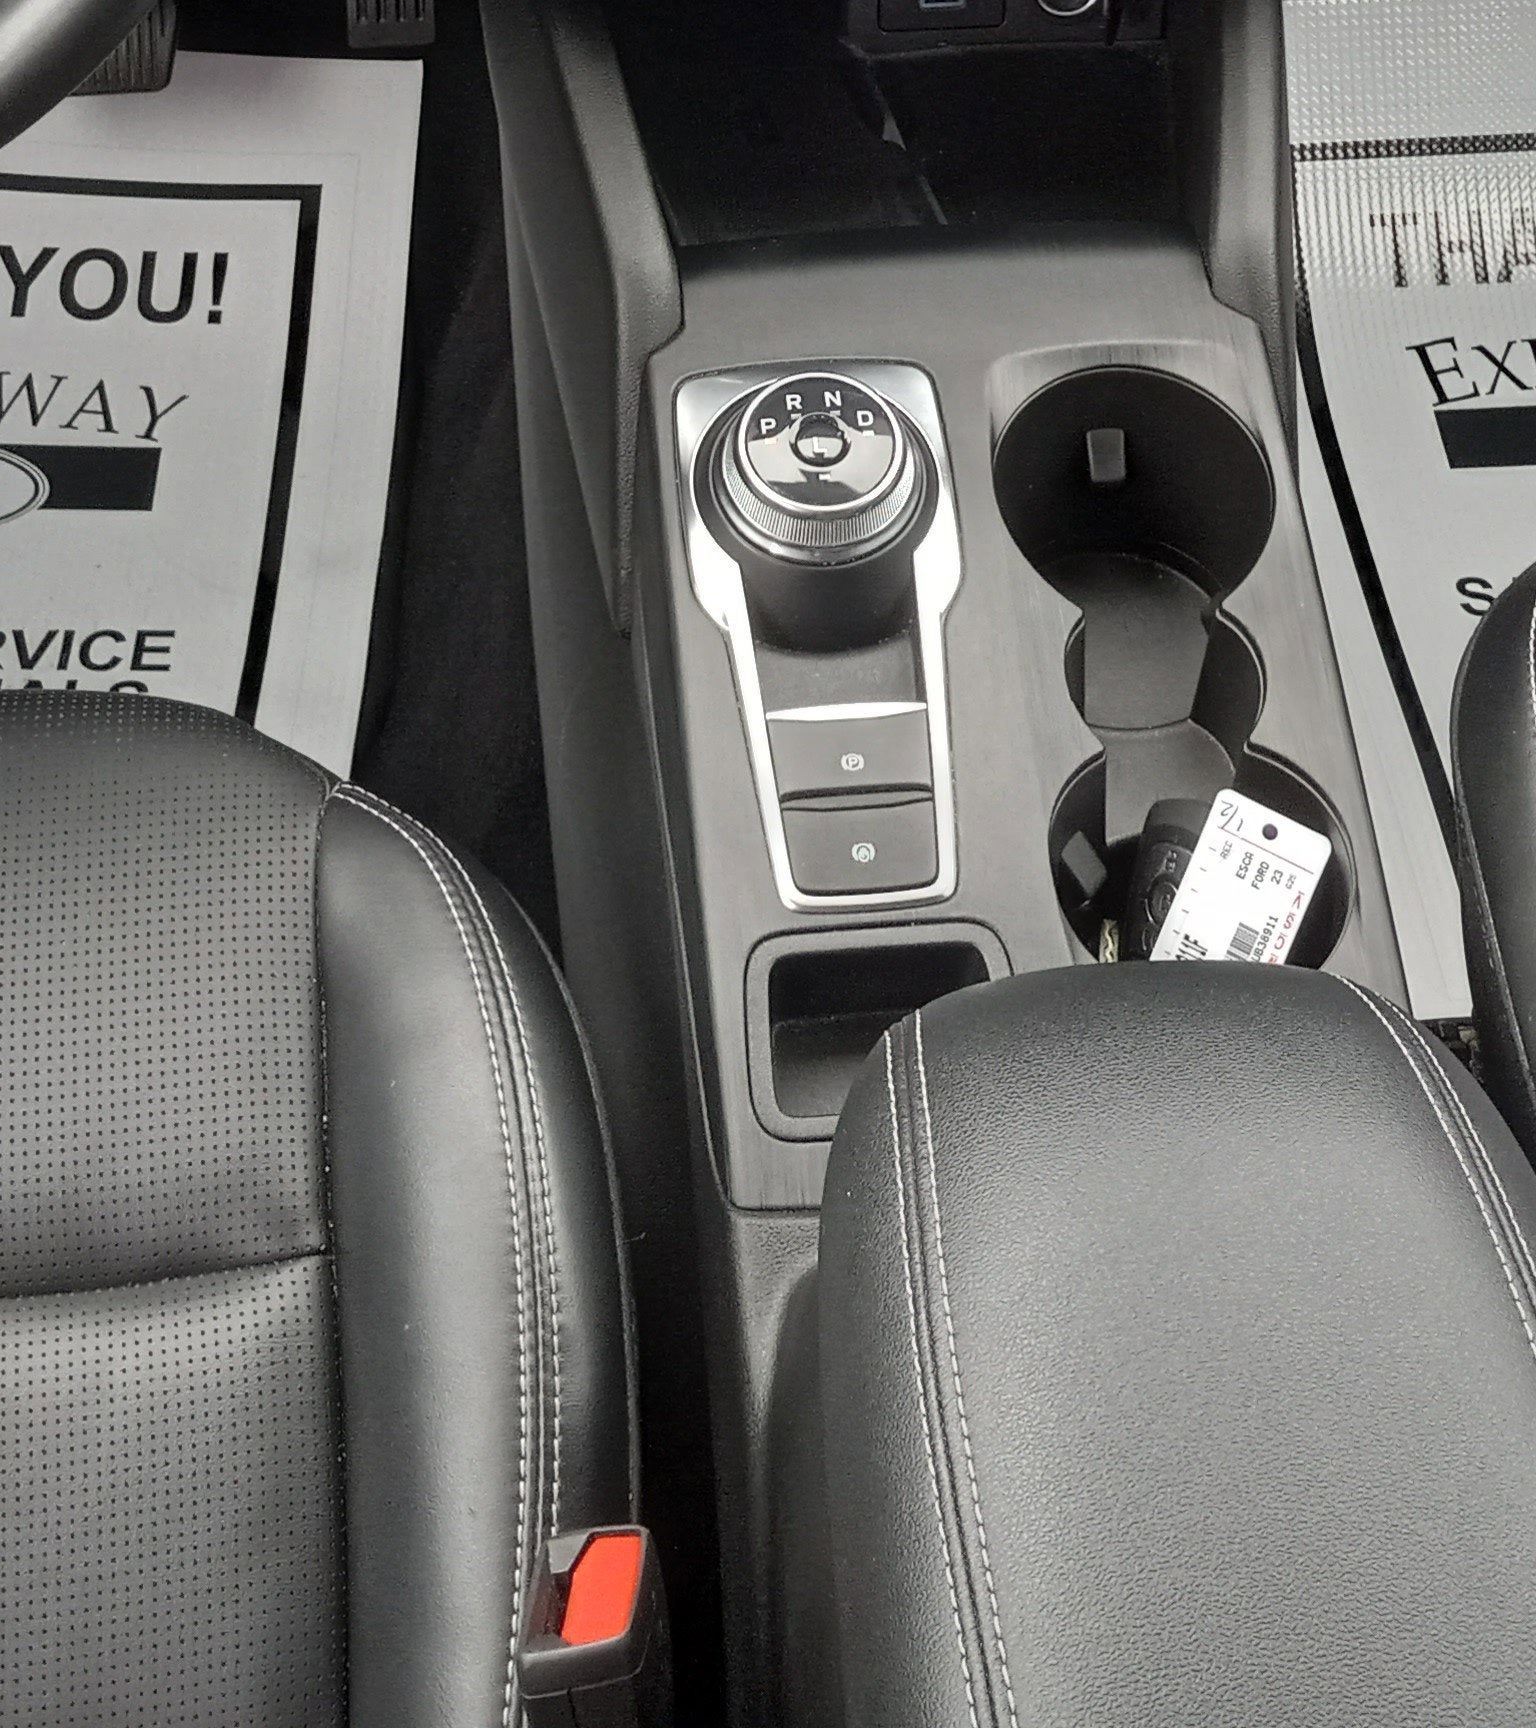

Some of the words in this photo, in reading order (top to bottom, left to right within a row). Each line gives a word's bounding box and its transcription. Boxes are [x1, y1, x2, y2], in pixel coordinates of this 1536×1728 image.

[760, 418, 777, 436] P
[786, 393, 802, 410] R
[825, 391, 841, 408] N
[857, 410, 874, 427] D
[813, 438, 827, 454] L
[1236, 852, 1254, 879] ESCA
[1251, 861, 1269, 890] FORD
[1271, 870, 1283, 884] 23
